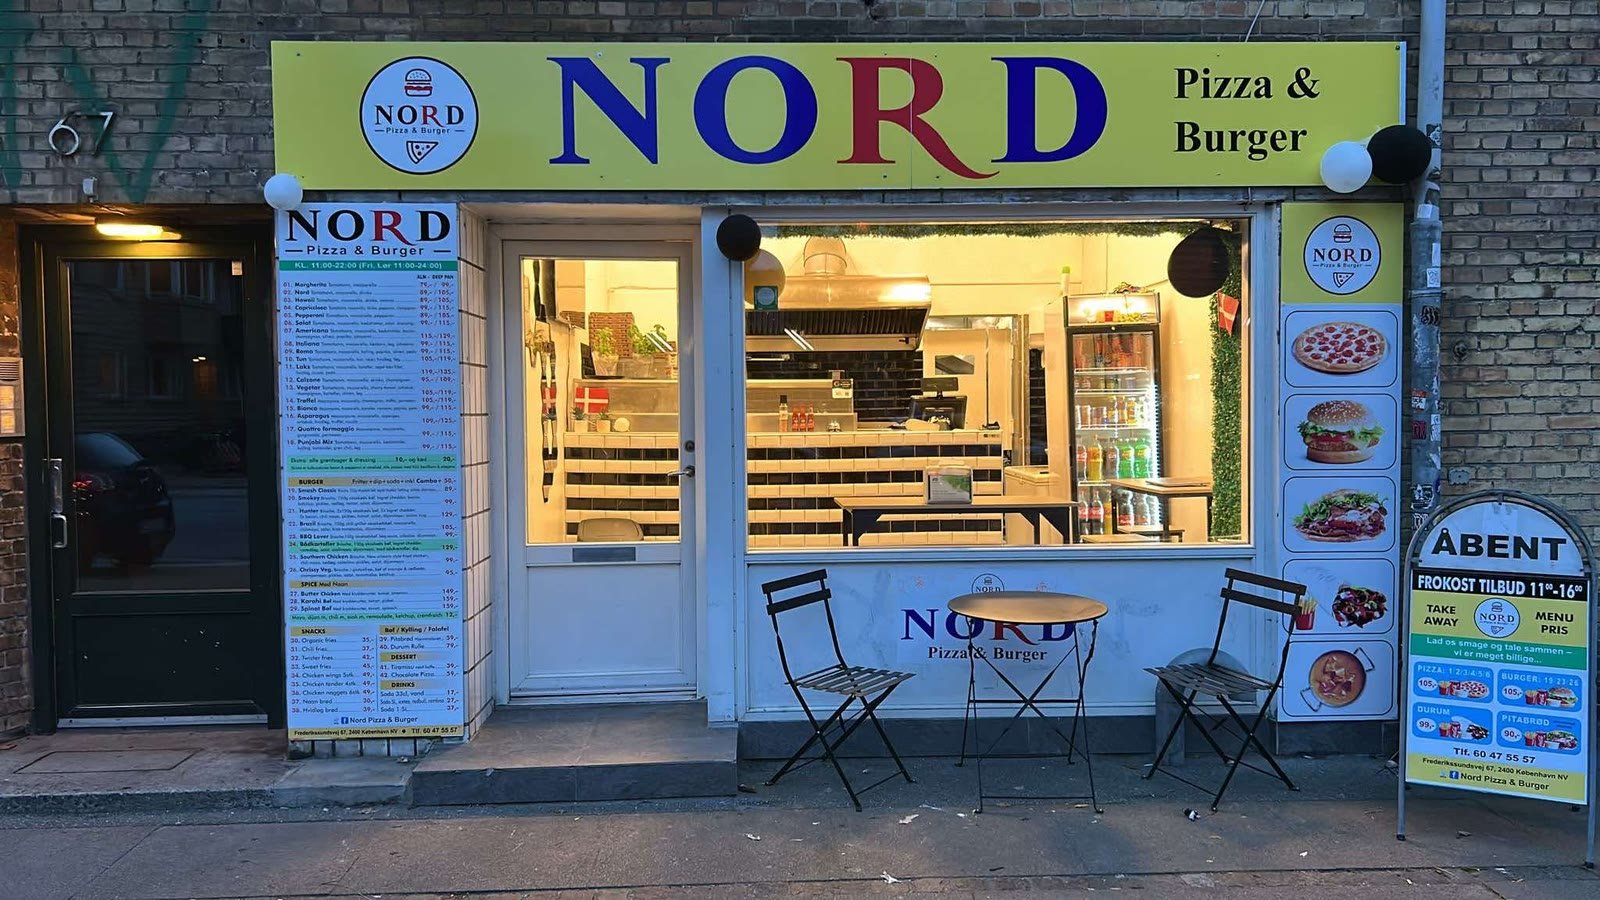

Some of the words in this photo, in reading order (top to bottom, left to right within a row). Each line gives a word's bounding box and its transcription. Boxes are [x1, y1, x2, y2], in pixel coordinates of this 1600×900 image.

[1173, 67, 1273, 100] Pizza
[1287, 66, 1320, 100] &
[375, 105, 464, 128] NORD
[547, 55, 1108, 179] NORD
[49, 111, 113, 156] 67
[421, 127, 450, 135] Burger
[1173, 121, 1308, 162] Burger
[285, 210, 450, 246] NORD
[307, 246, 347, 255] Pizza
[354, 246, 364, 255] &
[371, 246, 424, 257] Burger
[1313, 248, 1372, 263] NORD
[1431, 527, 1567, 561] ÅBENT
[1418, 575, 1476, 592] FROKOST
[1479, 579, 1525, 595] TILBUD
[1427, 605, 1456, 614] TAKE
[1424, 617, 1458, 626] AWAY
[1479, 612, 1515, 622] NORD
[1535, 612, 1574, 622] MENU
[1541, 625, 1568, 634] PRIS
[1427, 637, 1443, 646] Lad
[1458, 641, 1488, 649] smage
[1524, 646, 1564, 655] sammen
[928, 647, 968, 659] Pizza
[974, 648, 987, 659] &
[993, 648, 1047, 663] Burger
[1476, 652, 1503, 661] meget
[1417, 664, 1445, 673] PIZZA:
[1419, 679, 1437, 687] 105,-
[1501, 673, 1540, 683] BURGER:
[1503, 687, 1522, 696] 105,-
[1417, 706, 1449, 715] DURUM
[1501, 715, 1550, 726] PITABRØD
[1454, 748, 1470, 756] Tlf.
[1473, 750, 1486, 758] 60
[1489, 751, 1502, 759] 47
[1506, 753, 1519, 761] 55
[1422, 758, 1485, 771] Frederikssundsvej
[1498, 766, 1514, 774] 2400
[1516, 768, 1556, 779] København
[1461, 773, 1482, 782] Nord
[1484, 775, 1507, 785] Pizza
[1519, 779, 1549, 790] Burger
